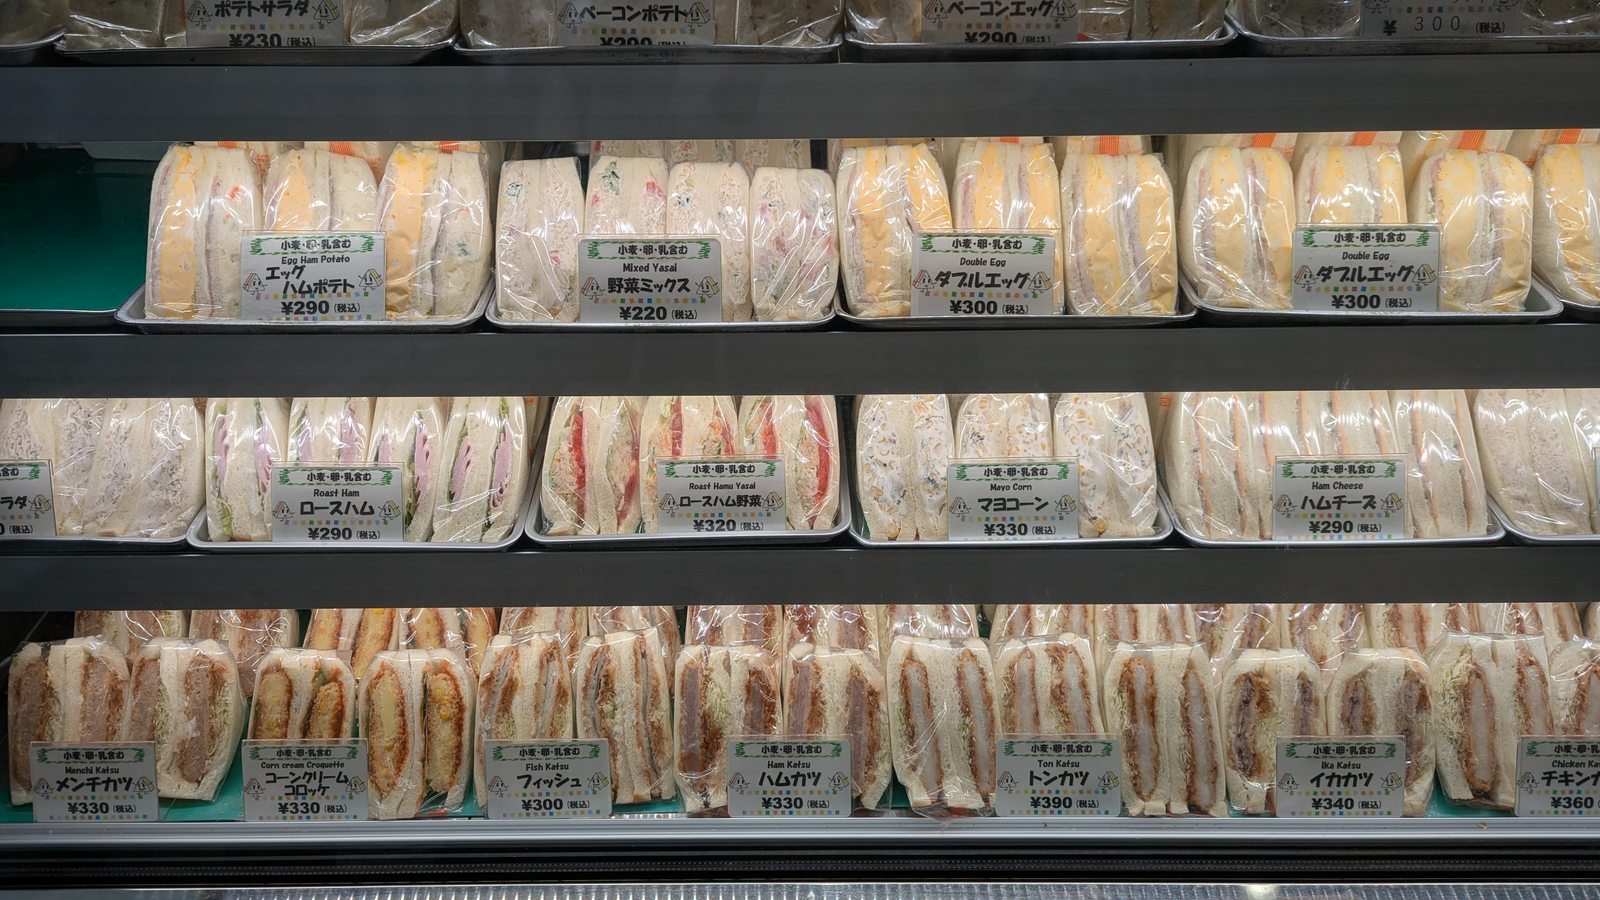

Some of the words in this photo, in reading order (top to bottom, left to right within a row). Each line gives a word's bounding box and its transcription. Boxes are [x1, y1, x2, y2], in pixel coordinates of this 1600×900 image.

[214, 0, 310, 17] ポテトサラダ
[580, 4, 687, 22] ベーコンポテト
[947, 0, 1055, 17] ベーコンエッグ
[1476, 21, 1505, 33] (税込)
[229, 33, 282, 48] ¥230
[287, 36, 316, 47] (税込)
[964, 31, 1017, 43] ¥290
[1333, 232, 1406, 243] 小麦・卵・乳含む
[618, 244, 688, 255] 小麦・卵・乳含む
[952, 238, 1023, 250] 小麦・卵・乳含む
[281, 256, 298, 265] Egg
[300, 256, 319, 264] Ham
[320, 255, 350, 264] Potato
[1342, 251, 1370, 261] Double
[1373, 252, 1390, 261] Egg
[623, 263, 650, 272] Mixed
[652, 263, 677, 272] Yasai
[960, 257, 987, 266] Double
[990, 258, 1006, 268] Egg
[265, 265, 306, 280] エッグ
[1316, 265, 1414, 283] ダブルエッグ
[607, 277, 691, 294] 野菜ミックス
[934, 271, 1030, 289] ダブルエッグ
[282, 279, 355, 295] ハムポテト
[281, 300, 330, 315] ¥290
[334, 303, 361, 313] (税込)
[949, 300, 998, 315] ¥300
[1002, 304, 1029, 315] (税込)
[1331, 294, 1381, 309] ¥300
[1385, 297, 1413, 308] (税込)
[619, 306, 667, 321] ¥220
[671, 310, 698, 320] (税込)
[0, 467, 19, 477] 含む
[692, 464, 756, 474] 小麦・卵・乳含む
[984, 467, 1048, 477] 小麦・卵・乳含む
[1310, 464, 1376, 475] 小麦・卵・乳含む
[307, 472, 372, 482] 小麦・卵・乳含む
[689, 482, 711, 490] Roast
[735, 482, 756, 490] Yasai
[990, 483, 1011, 492] Mayo
[1012, 483, 1032, 491] Corn
[1311, 482, 1330, 490] Ham
[1332, 481, 1364, 490] Cheese
[313, 489, 339, 497] Roast
[341, 489, 360, 497] Ham
[680, 494, 762, 508] ロースハム野菜
[977, 496, 1049, 512] マヨコーン
[1300, 495, 1377, 511] ハムチーズ
[300, 501, 376, 516] ロースハム
[9, 524, 33, 534] (税込)
[692, 519, 737, 532] ¥320
[740, 521, 764, 532] (税込)
[984, 523, 1028, 536] ¥330
[1031, 526, 1057, 535] (税込)
[1309, 520, 1354, 534] ¥290
[1357, 523, 1382, 533] (税込)
[308, 527, 352, 540] ¥290
[356, 530, 381, 540] (税込)
[276, 748, 332, 757] 小麦・卵・乳含む
[519, 747, 580, 757] 小麦・卵・乳含む
[761, 745, 822, 754] 小麦・卵・乳含む
[1031, 744, 1093, 753] 小麦・卵・乳含む
[1313, 746, 1376, 755] 小麦・卵・乳含む
[63, 751, 125, 760] 小麦・卵・乳含む
[261, 761, 280, 769] Corn
[306, 761, 345, 769] Croquette
[526, 763, 544, 771] Fish
[545, 763, 569, 771] Katsu
[767, 761, 785, 769] Ham
[787, 761, 811, 769] Katsu
[1038, 760, 1054, 768] Ton
[1055, 760, 1080, 768] Katsu
[1321, 761, 1335, 770] Ika
[1336, 761, 1361, 770] Katsu
[1551, 760, 1586, 768] Chicken
[65, 766, 93, 775] Menchi
[95, 766, 120, 774] Katsu
[265, 771, 349, 784] コーンクリーム
[516, 773, 582, 789] フィッシュ
[758, 771, 822, 787] ハムカツ
[1029, 770, 1090, 787] トンカツ
[1309, 771, 1374, 788] イカカツ
[56, 777, 133, 792] メンチカツ
[284, 784, 330, 796] コロッケ
[67, 802, 110, 815] ¥330
[113, 804, 137, 813] (税込)
[278, 802, 321, 814] ¥330
[324, 804, 348, 813] (税込)
[521, 798, 564, 811] ¥300
[567, 800, 591, 809] (税込)
[761, 797, 804, 810] ¥330
[807, 799, 830, 809] (税込)
[1030, 796, 1073, 809] ¥390
[1076, 799, 1100, 809] (税込)
[1311, 797, 1355, 810] ¥340
[1358, 800, 1382, 809] (税込)
[1550, 796, 1594, 809] ¥360
